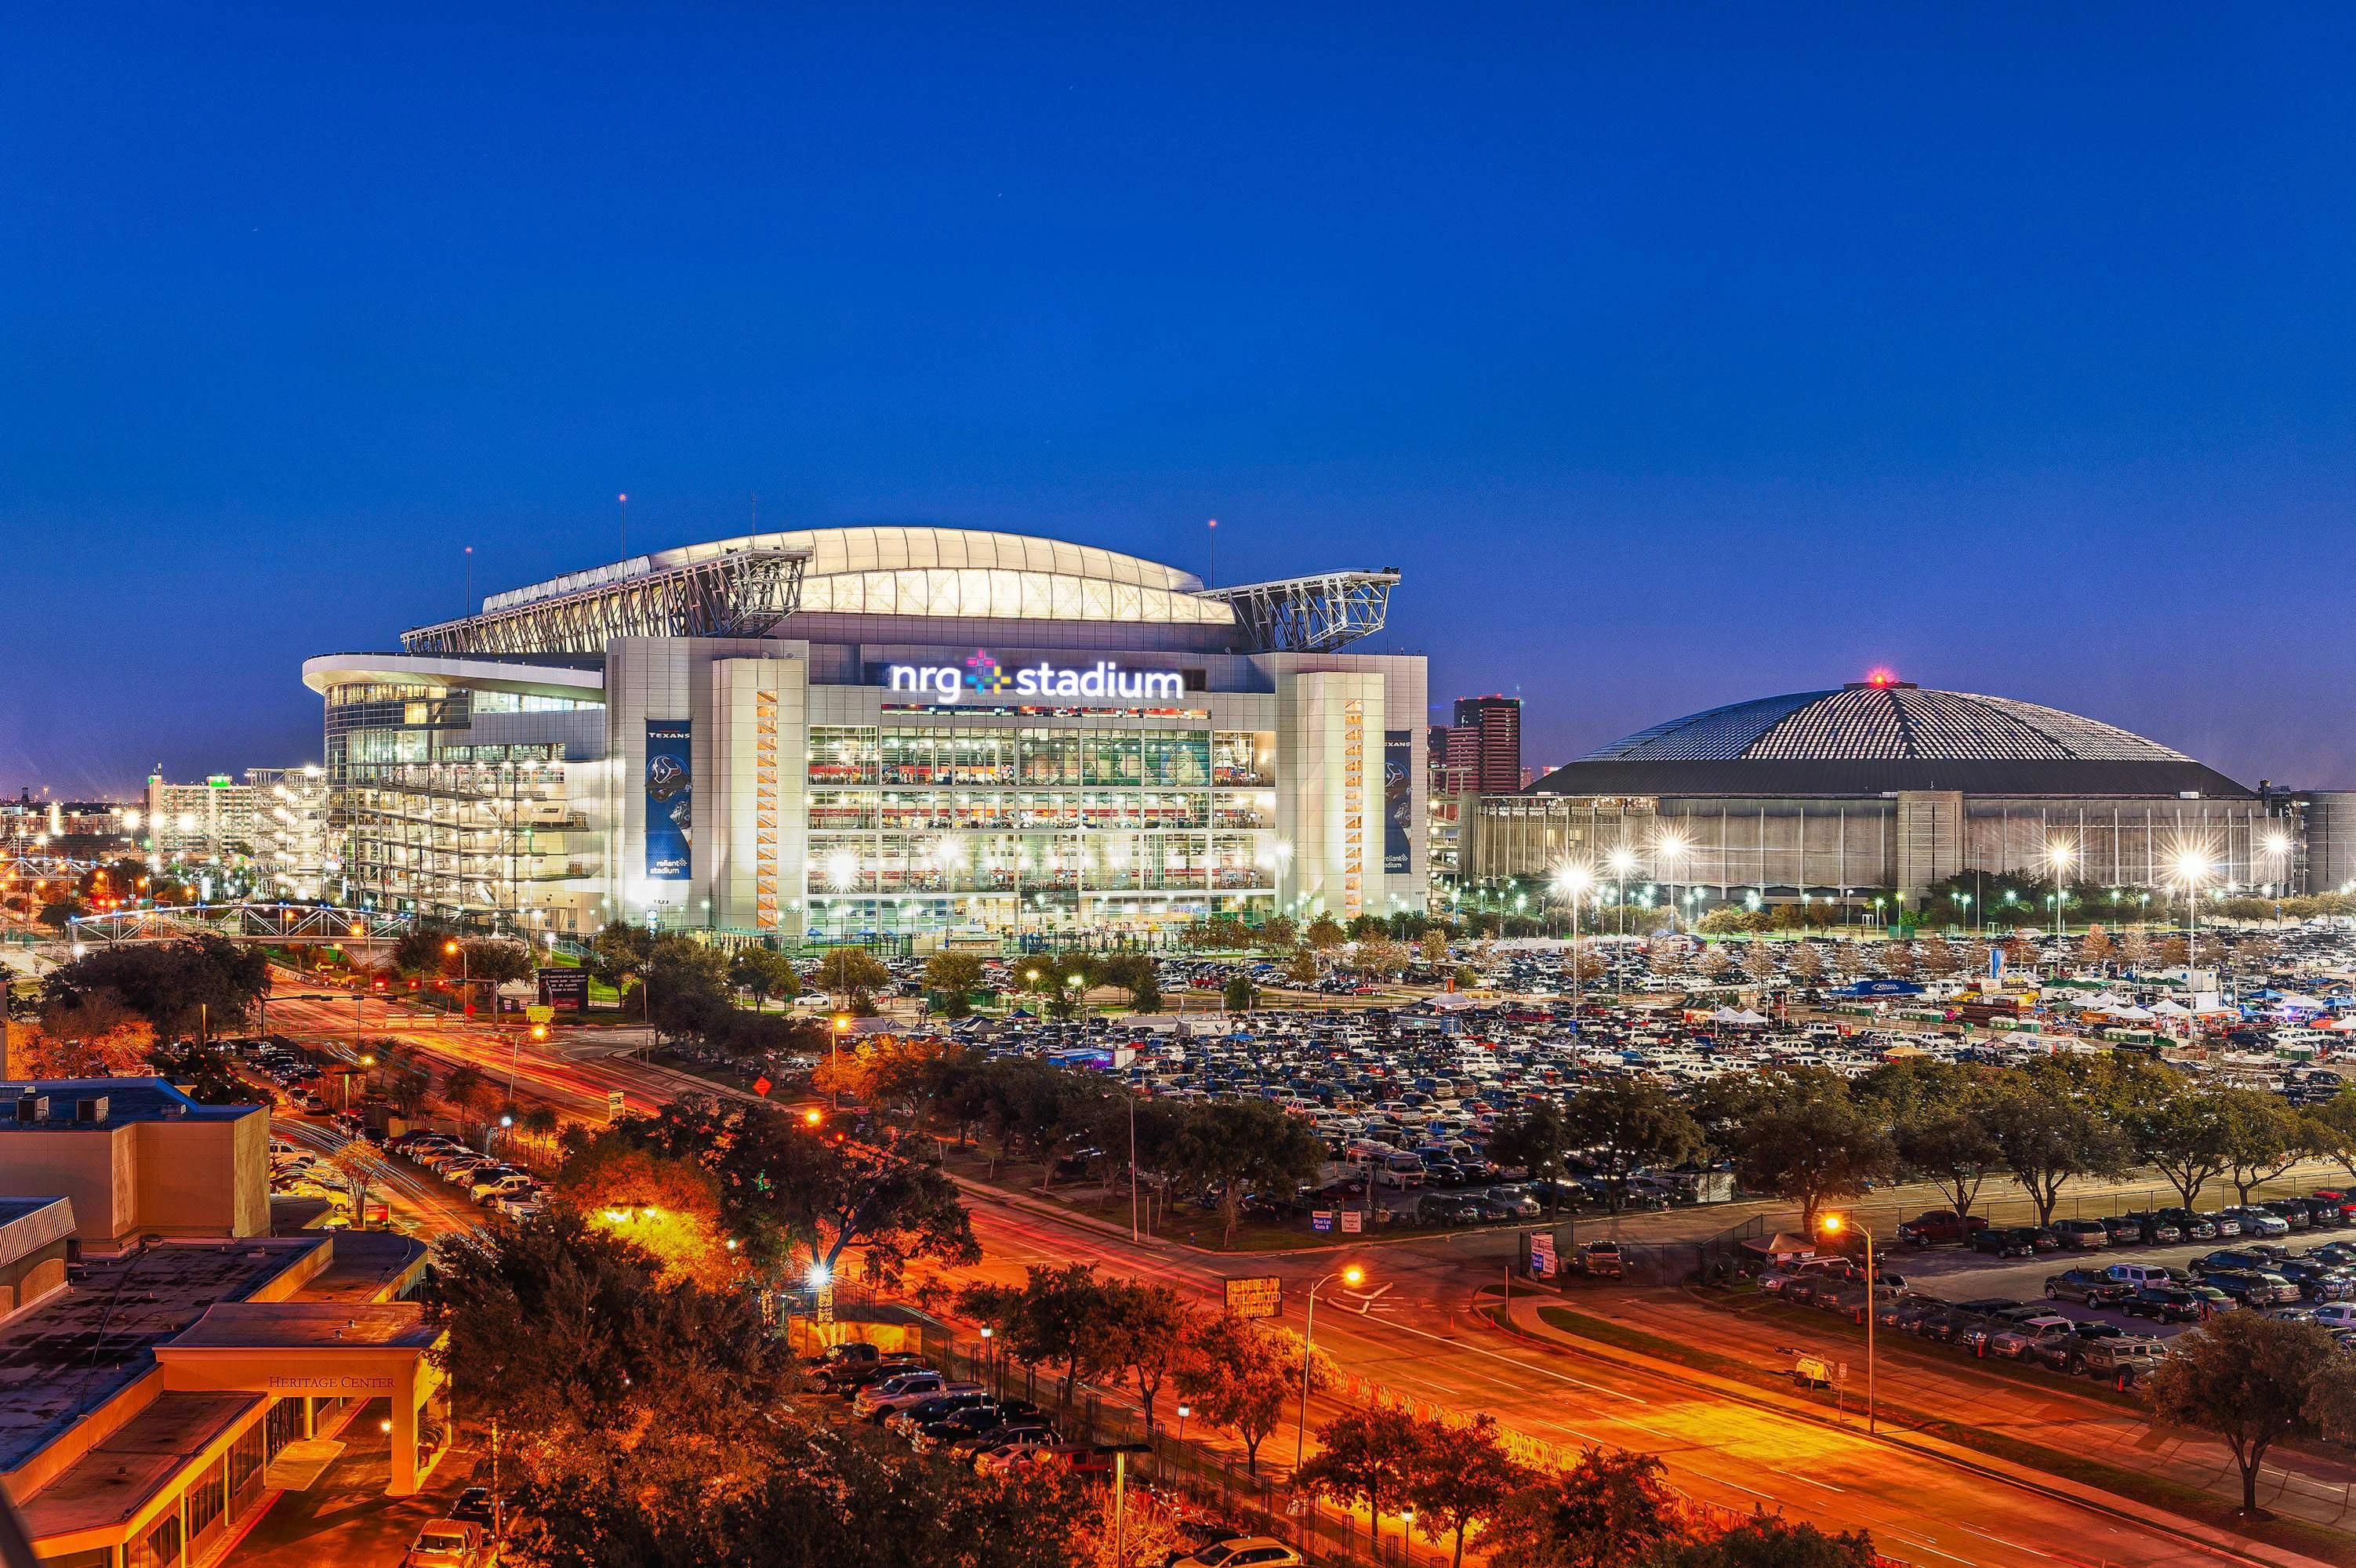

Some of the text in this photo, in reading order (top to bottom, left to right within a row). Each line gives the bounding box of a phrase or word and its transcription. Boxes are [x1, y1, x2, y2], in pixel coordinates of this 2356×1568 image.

[891, 661, 1185, 704] nrg stadium
[269, 1377, 395, 1388] HERITAGE CENTER
